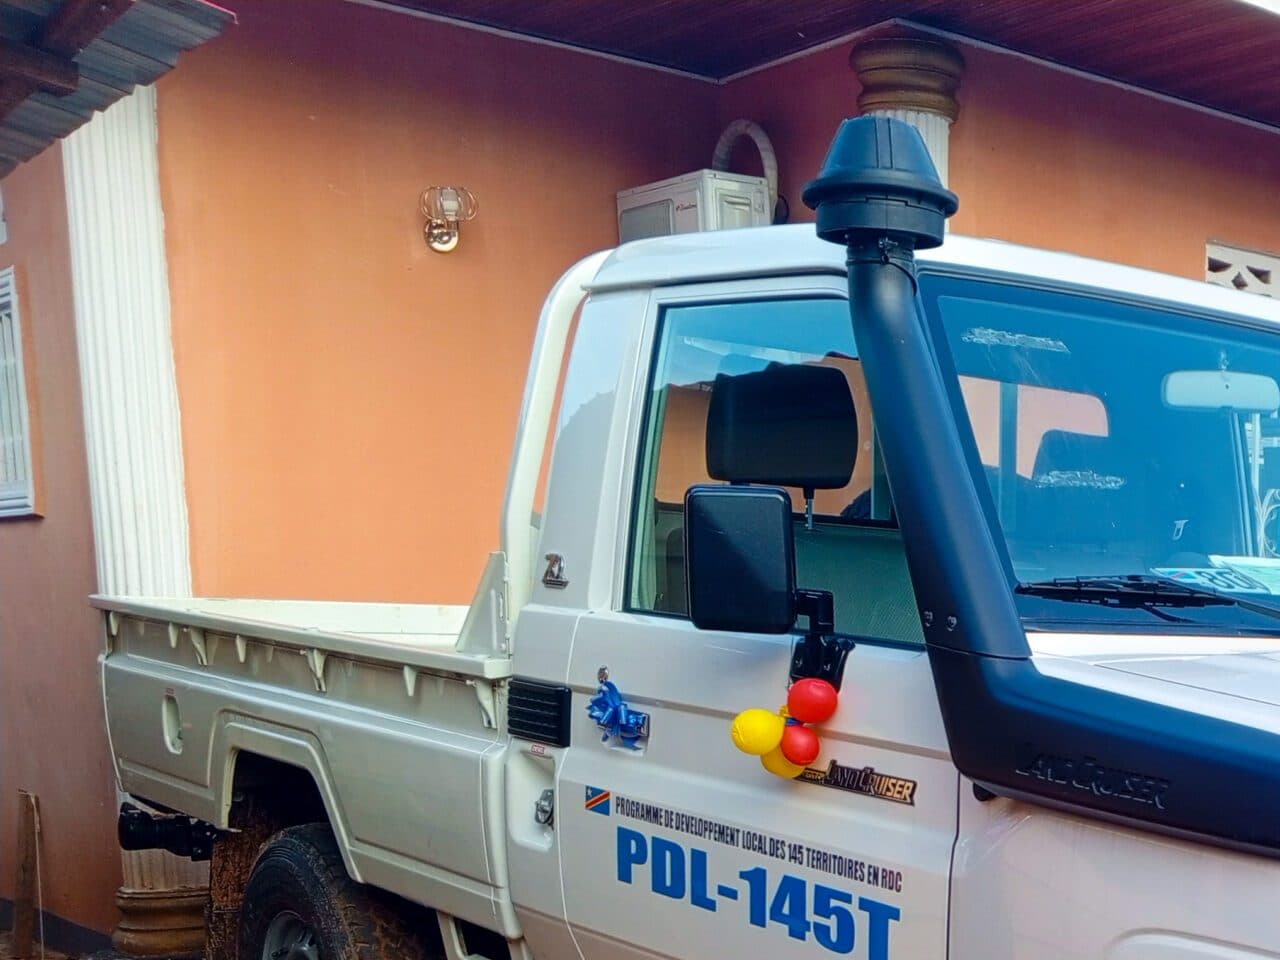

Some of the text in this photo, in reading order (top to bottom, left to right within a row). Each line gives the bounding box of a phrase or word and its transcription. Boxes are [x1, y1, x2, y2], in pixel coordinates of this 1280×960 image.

[615, 796, 903, 893] PROGRAMME DE DEVELOPPEMENT LOCAL DES 145 TERRITOIRES EN RDC
